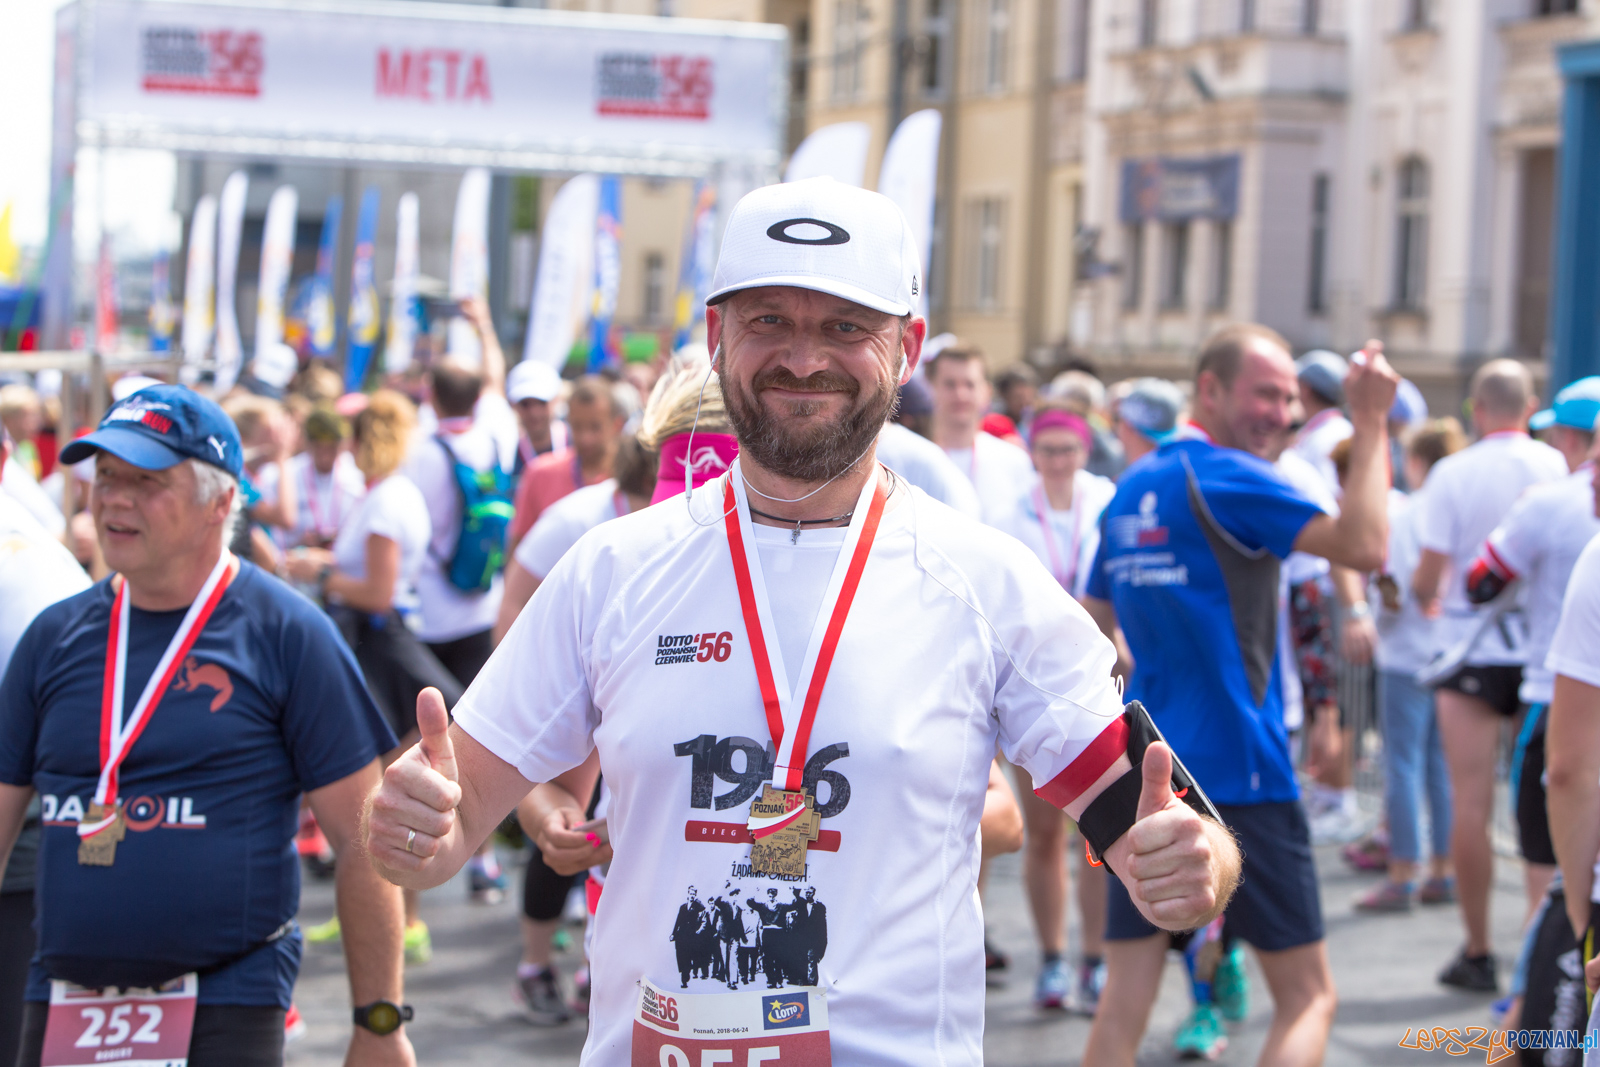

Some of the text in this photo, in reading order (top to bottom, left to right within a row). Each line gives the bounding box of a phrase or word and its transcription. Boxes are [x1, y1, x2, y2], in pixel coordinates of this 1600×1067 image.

[375, 49, 493, 104] META
[656, 645, 698, 656] POZNAŃSKI
[657, 630, 733, 663] LOTTO '56
[655, 654, 697, 665] CZERWIEC
[673, 734, 851, 819] 196
[753, 803, 785, 815] POZNAŃ
[701, 827, 737, 837] BIEG
[775, 1005, 798, 1020] LOTTO
[74, 1003, 163, 1048] 252
[717, 1027, 749, 1035] 2018-06-24
